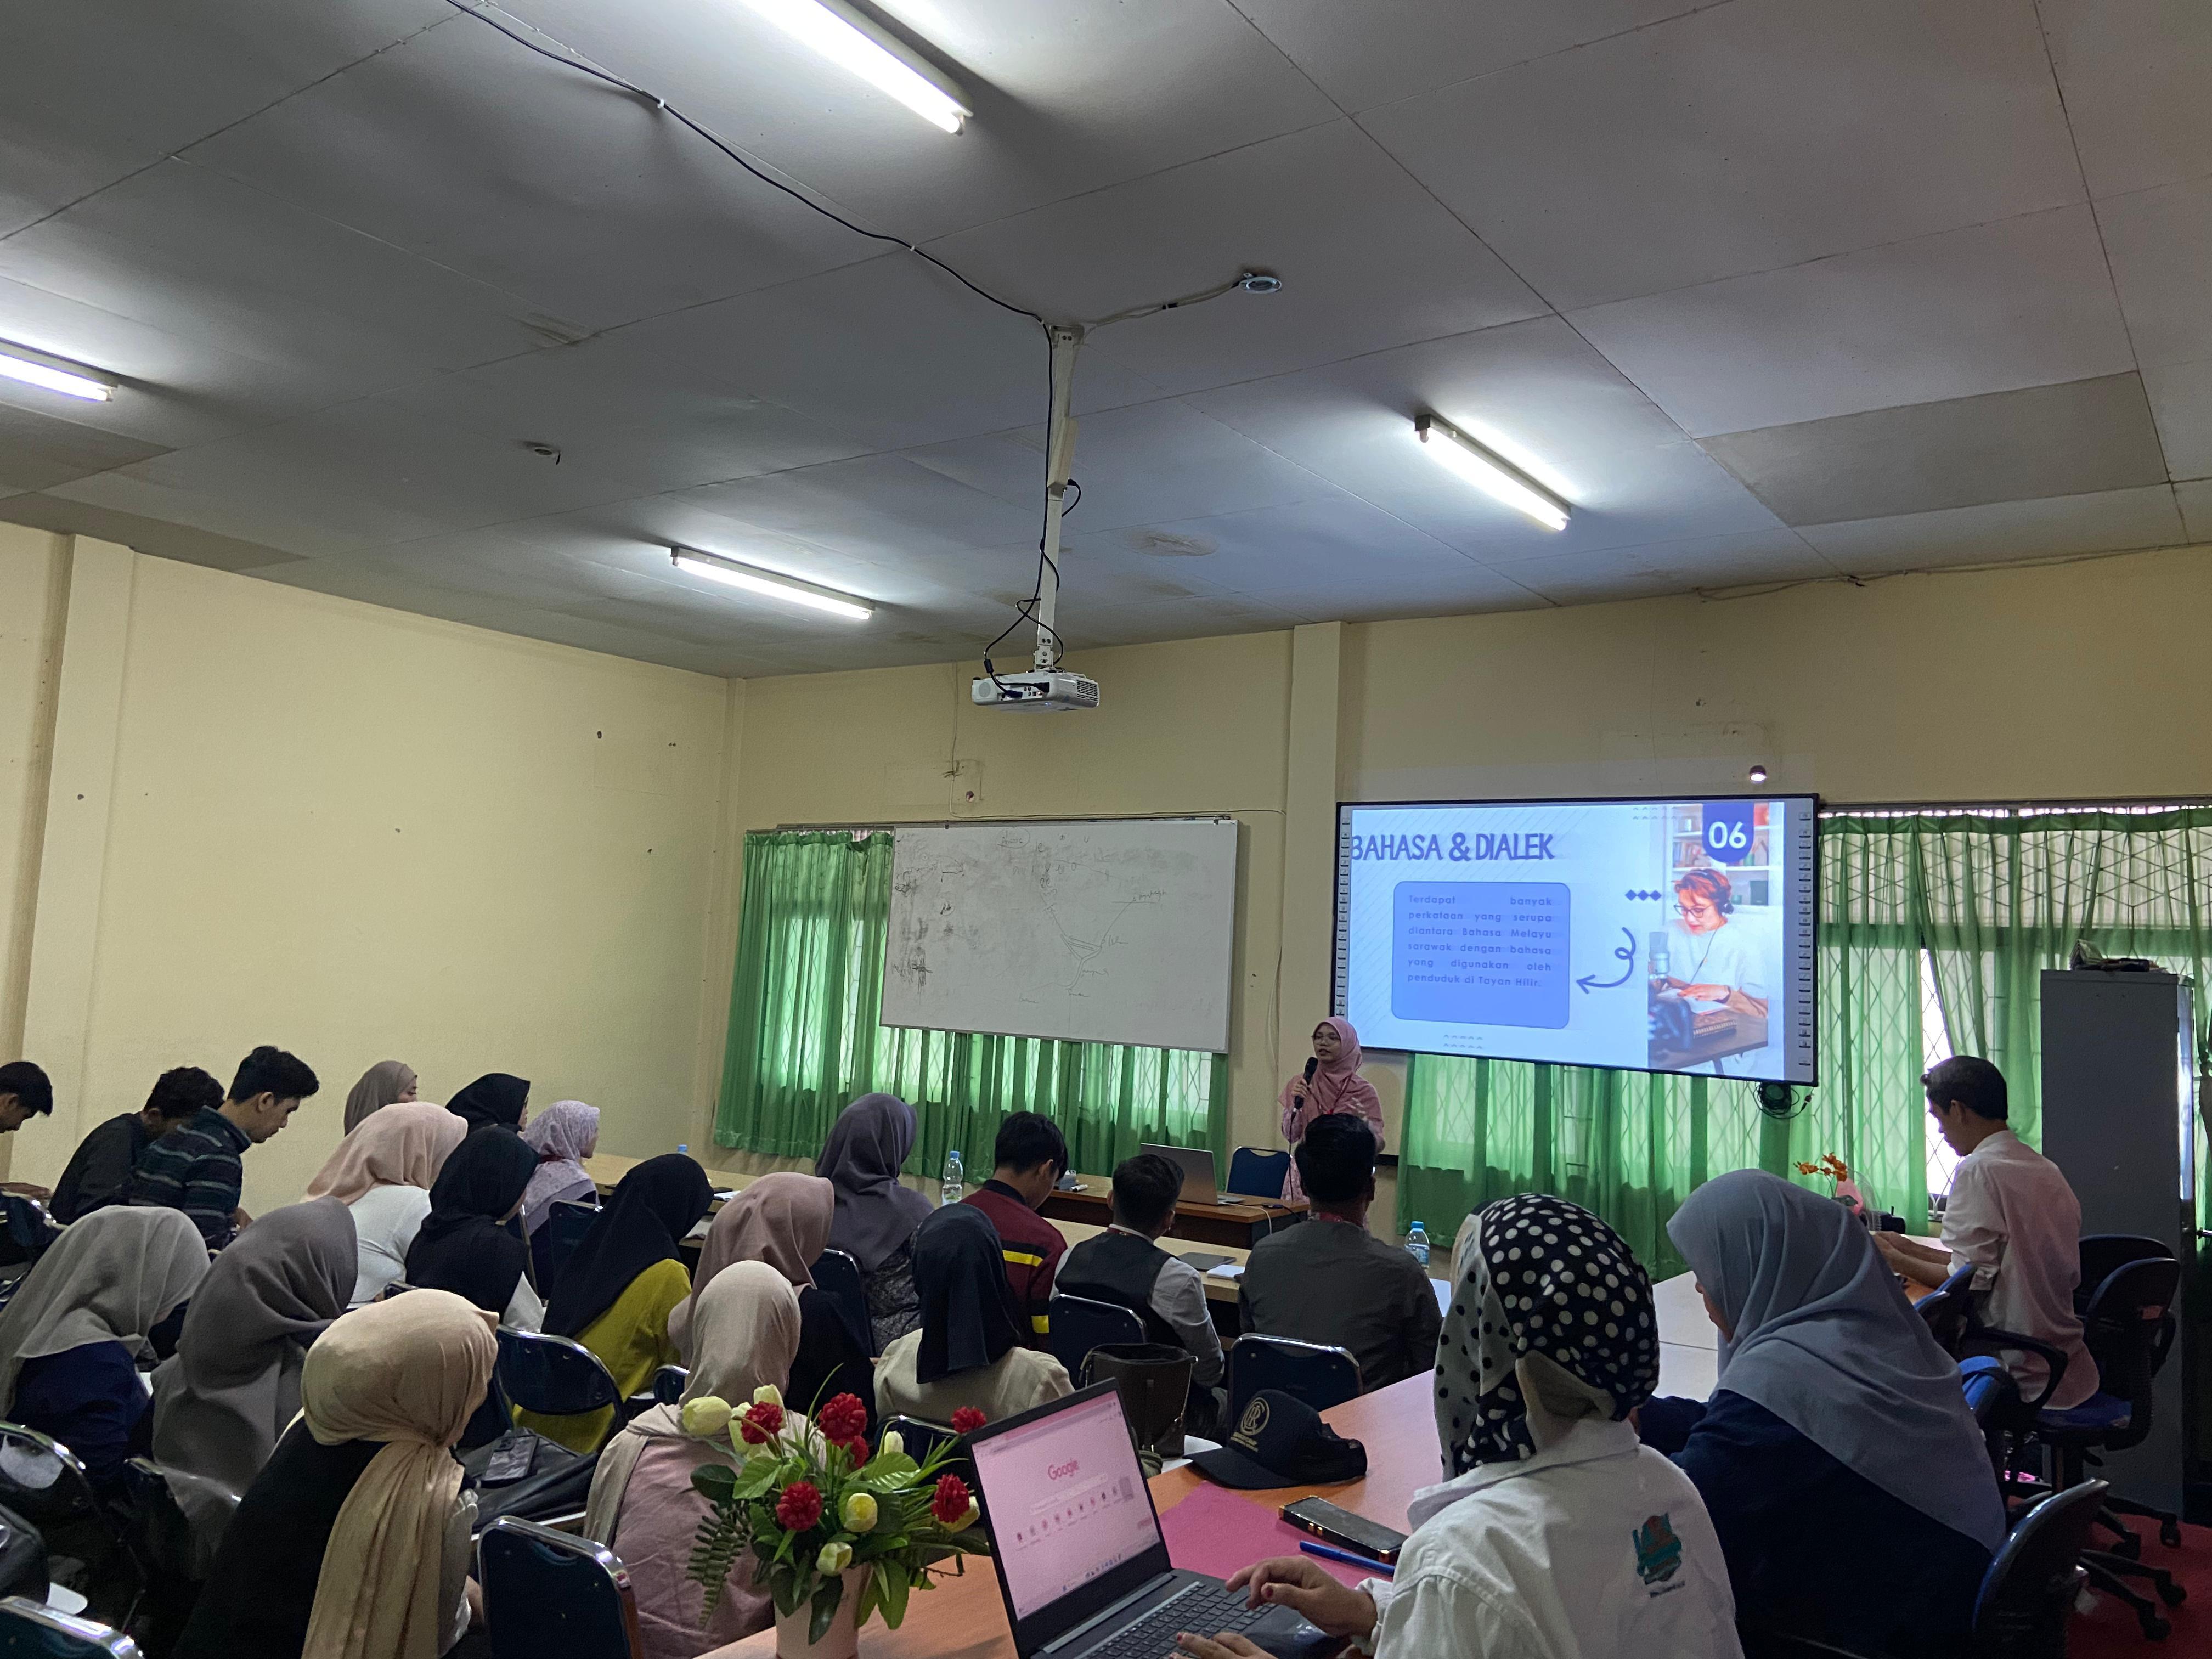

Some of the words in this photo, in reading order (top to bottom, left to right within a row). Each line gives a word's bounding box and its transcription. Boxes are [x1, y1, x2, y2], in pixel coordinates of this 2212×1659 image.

[1708, 821, 1746, 849] 06
[1352, 833, 1443, 861] BAHASA
[1449, 832, 1470, 862] &
[1476, 833, 1555, 860] DIALEK
[1408, 895, 1455, 905] Terdapat
[1510, 897, 1552, 906] banyak
[1408, 911, 1463, 920] perkataan
[1475, 913, 1502, 922] yang
[1513, 913, 1552, 922] serupa
[1408, 926, 1453, 935] diantara
[1463, 928, 1501, 937] Bahasa
[1510, 929, 1551, 939] Melayu
[1408, 943, 1452, 951] sarawak
[1460, 944, 1501, 953] dengan
[1510, 945, 1551, 955] bahasa
[1408, 959, 1434, 967] yang
[1451, 959, 1509, 969] digunakan
[1527, 963, 1551, 971] oleh
[1408, 974, 1460, 983] penduduk
[1465, 975, 1474, 984] di
[1479, 976, 1510, 986] Tayan
[1048, 1459, 1079, 1480] Google
